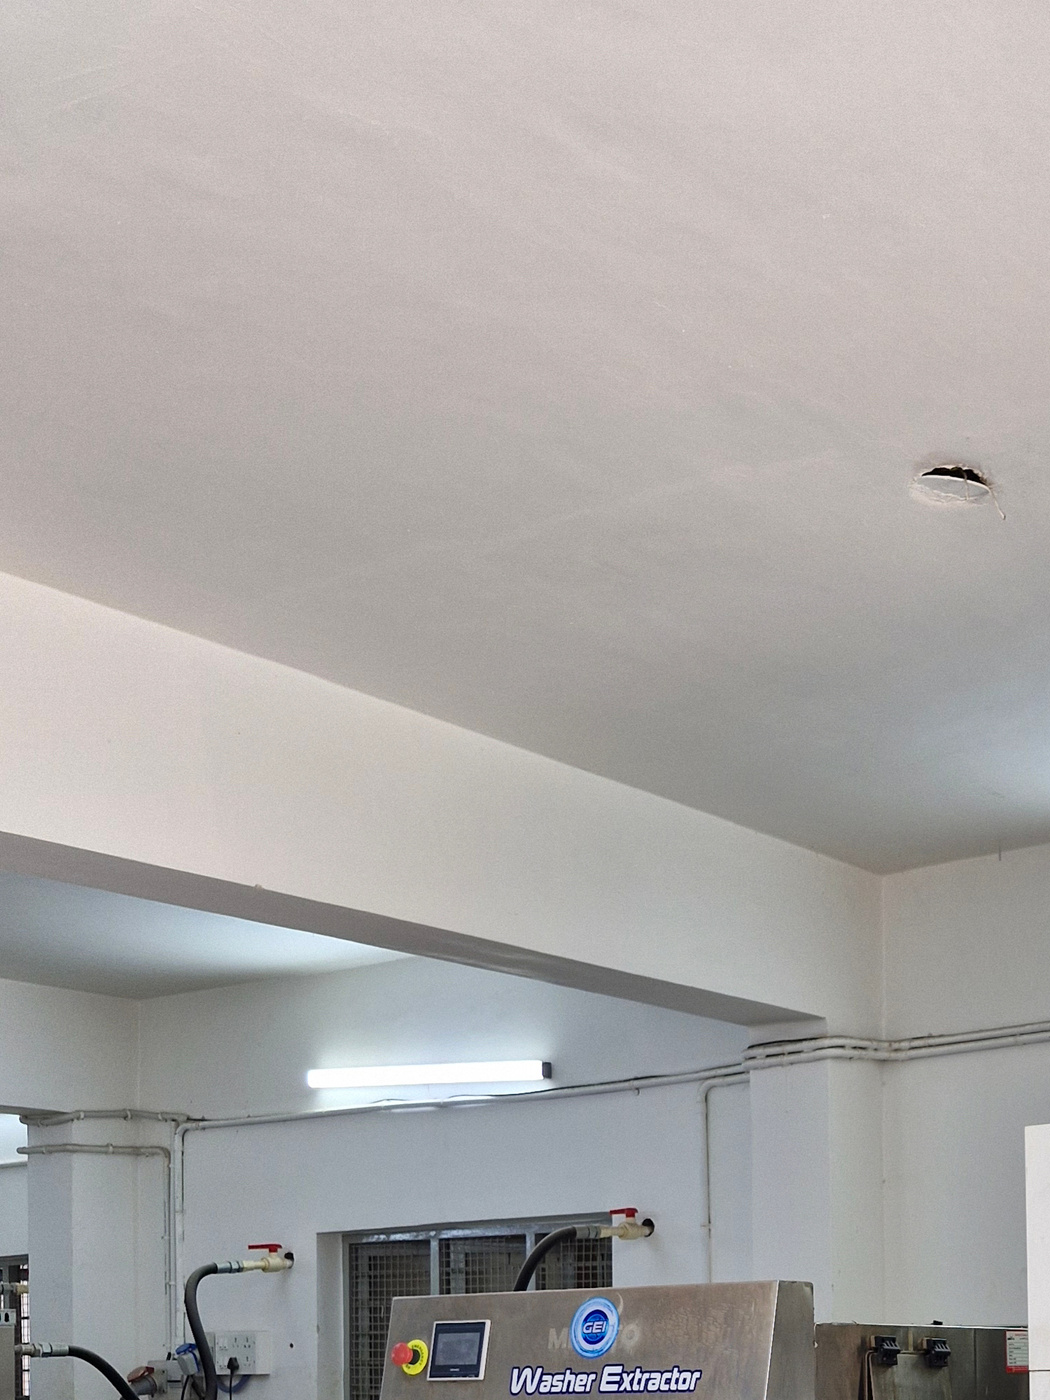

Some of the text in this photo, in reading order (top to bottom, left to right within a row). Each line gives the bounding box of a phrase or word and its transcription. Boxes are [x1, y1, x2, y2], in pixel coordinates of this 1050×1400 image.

[582, 1320, 607, 1334] GEI
[510, 1363, 703, 1396] Washer Extractor
